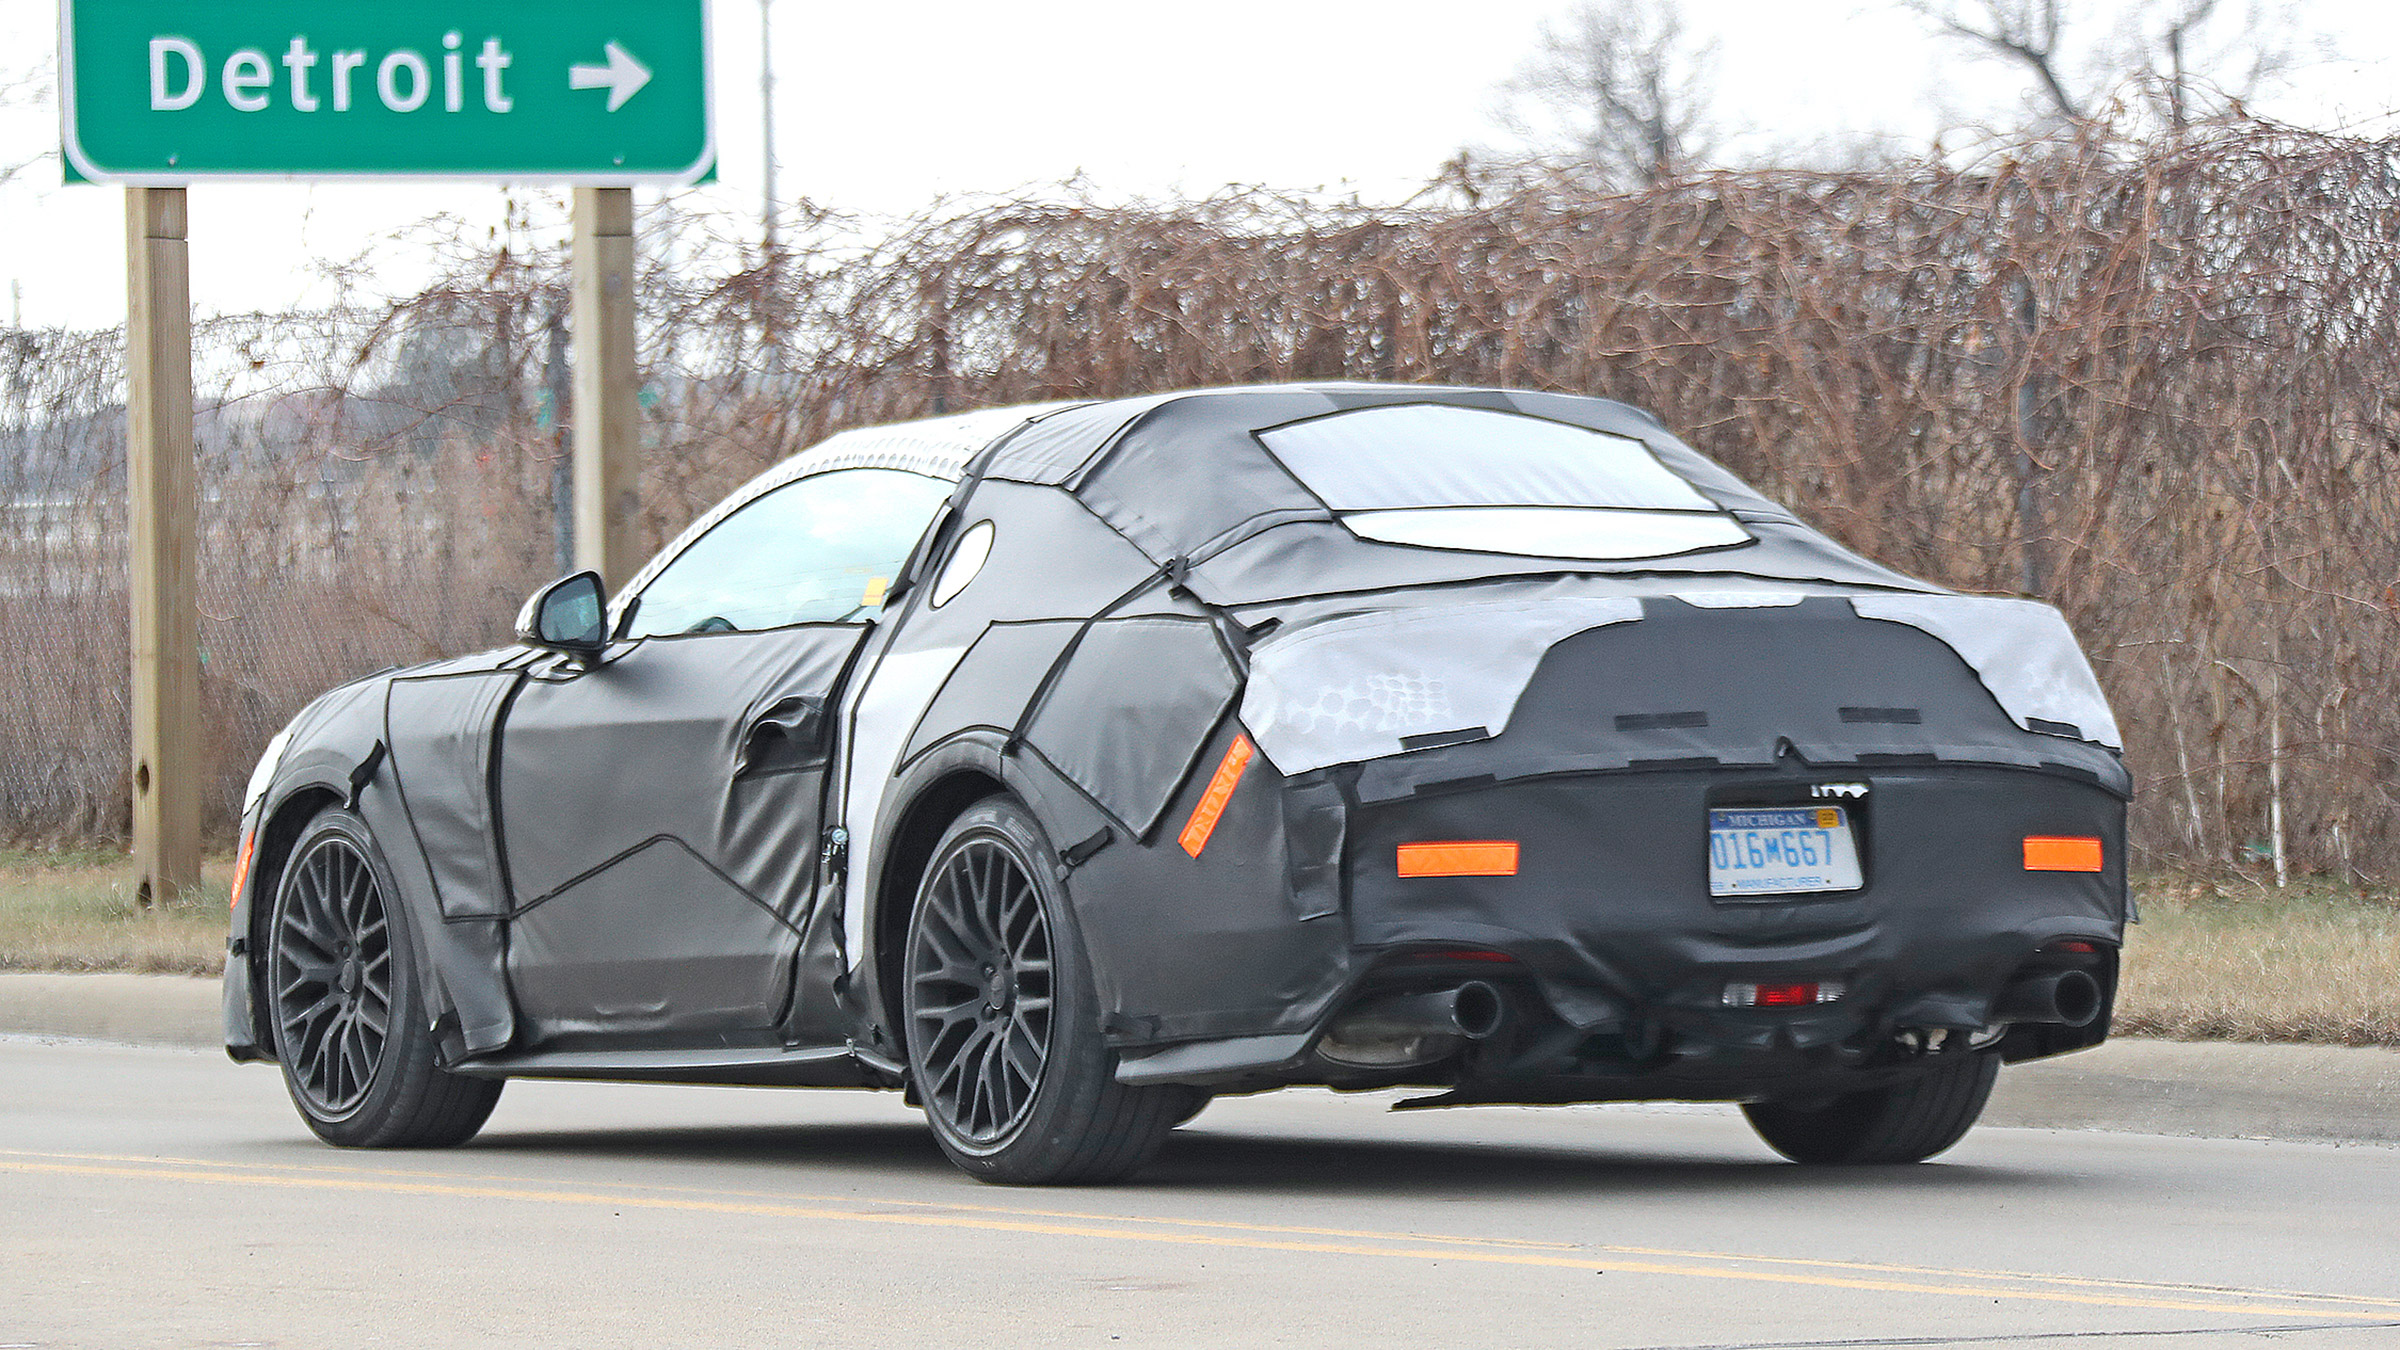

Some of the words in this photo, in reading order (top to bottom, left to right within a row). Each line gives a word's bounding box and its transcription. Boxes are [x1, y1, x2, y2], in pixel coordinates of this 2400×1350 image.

[149, 32, 512, 112] Detroit
[1728, 813, 1806, 827] MICHIGAN
[1711, 831, 1831, 869] 016M667
